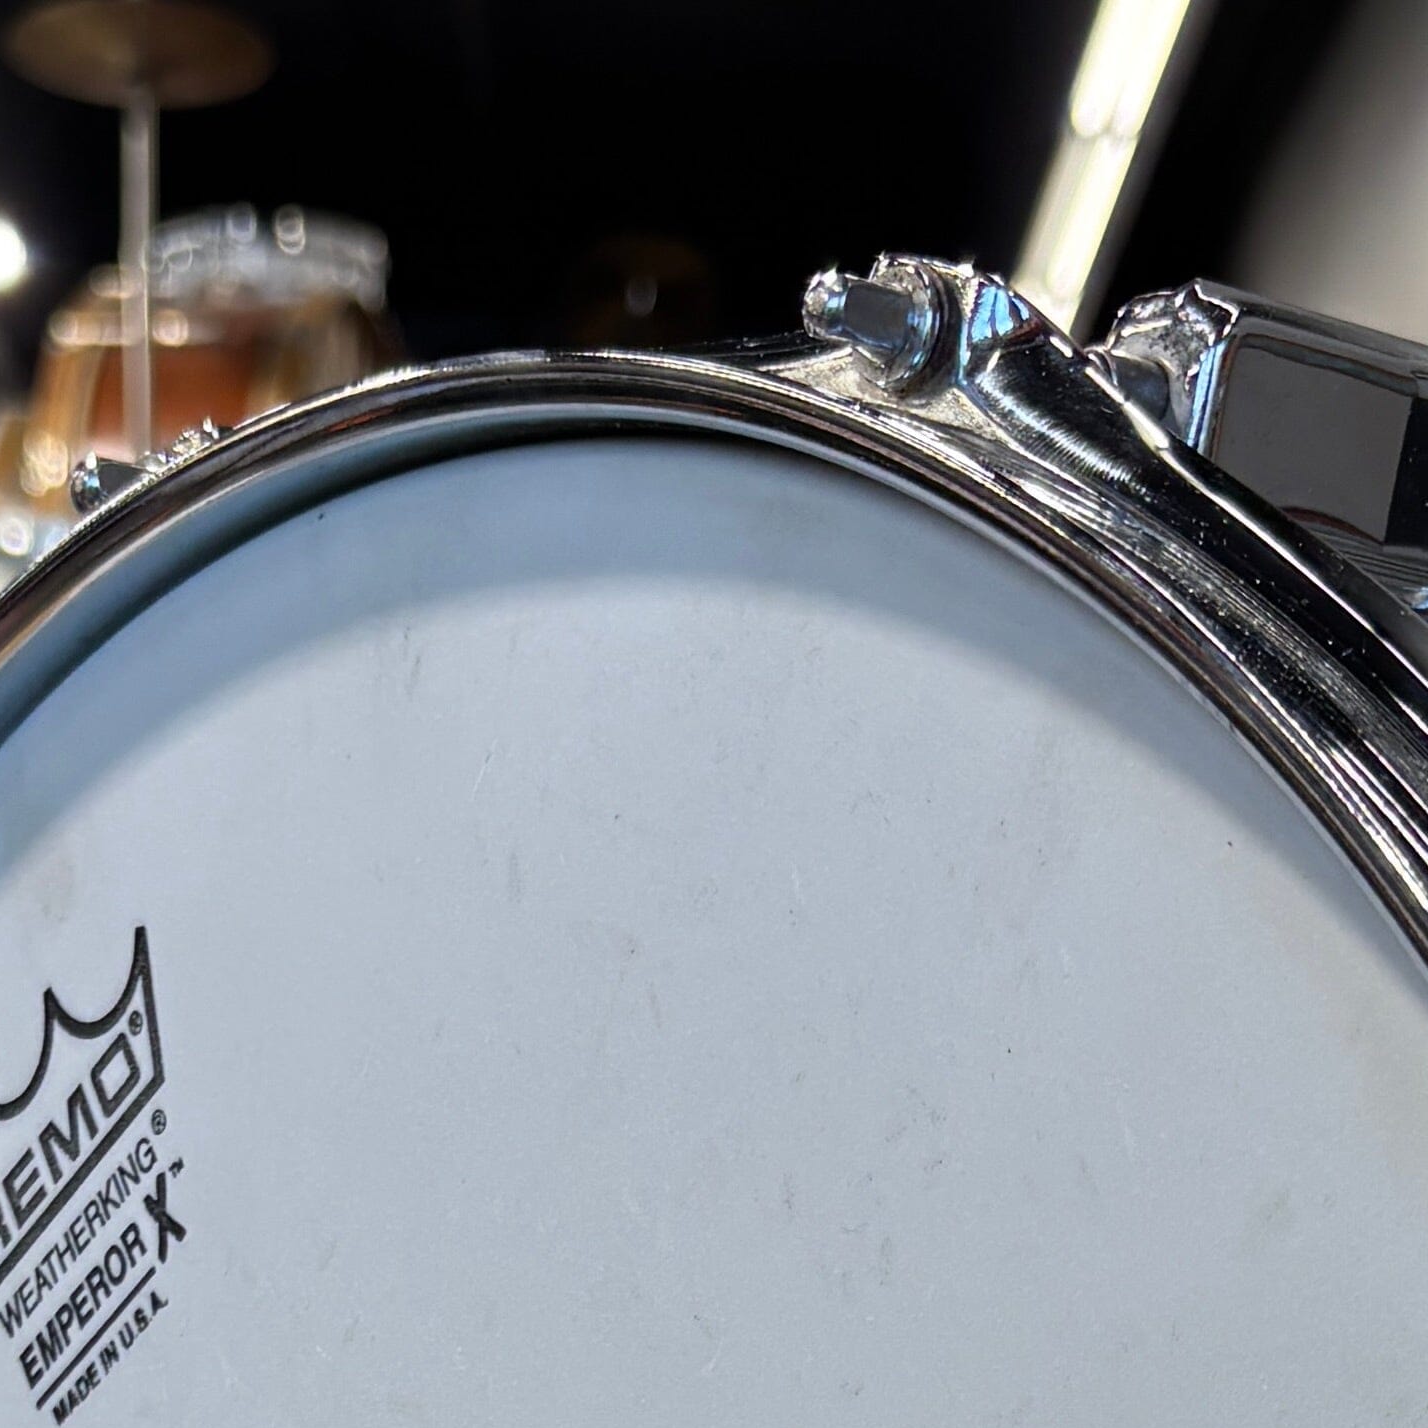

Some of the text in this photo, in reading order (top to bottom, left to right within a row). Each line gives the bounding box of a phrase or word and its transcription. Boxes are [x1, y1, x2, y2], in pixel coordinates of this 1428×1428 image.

[19, 1222, 147, 1389] EMPEROR
[52, 1362, 102, 1426] MADE
[99, 1340, 119, 1376] IN
